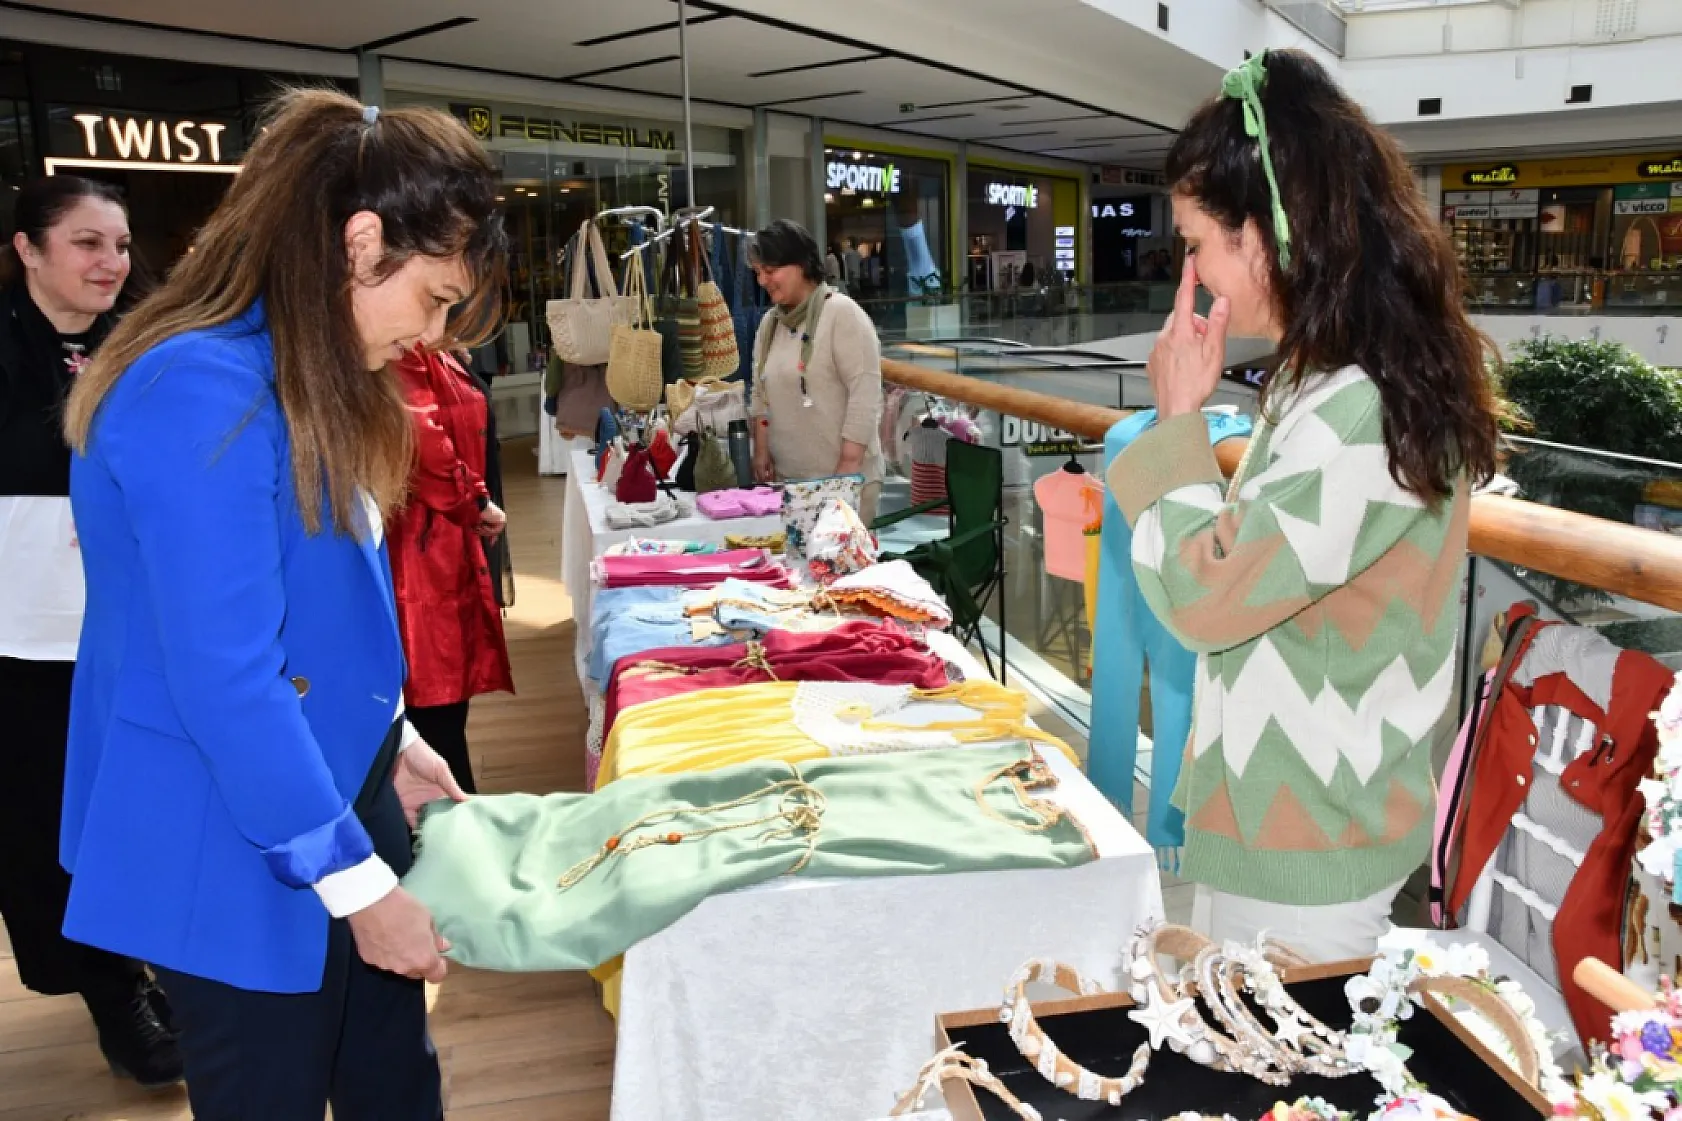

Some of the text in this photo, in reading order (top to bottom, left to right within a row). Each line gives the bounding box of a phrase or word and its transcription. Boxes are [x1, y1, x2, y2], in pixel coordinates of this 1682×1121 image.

[72, 113, 227, 163] TWIST
[499, 114, 675, 151] FENERIUM
[826, 162, 901, 193] SPORTIVE
[988, 183, 1038, 209] SPORTIVE
